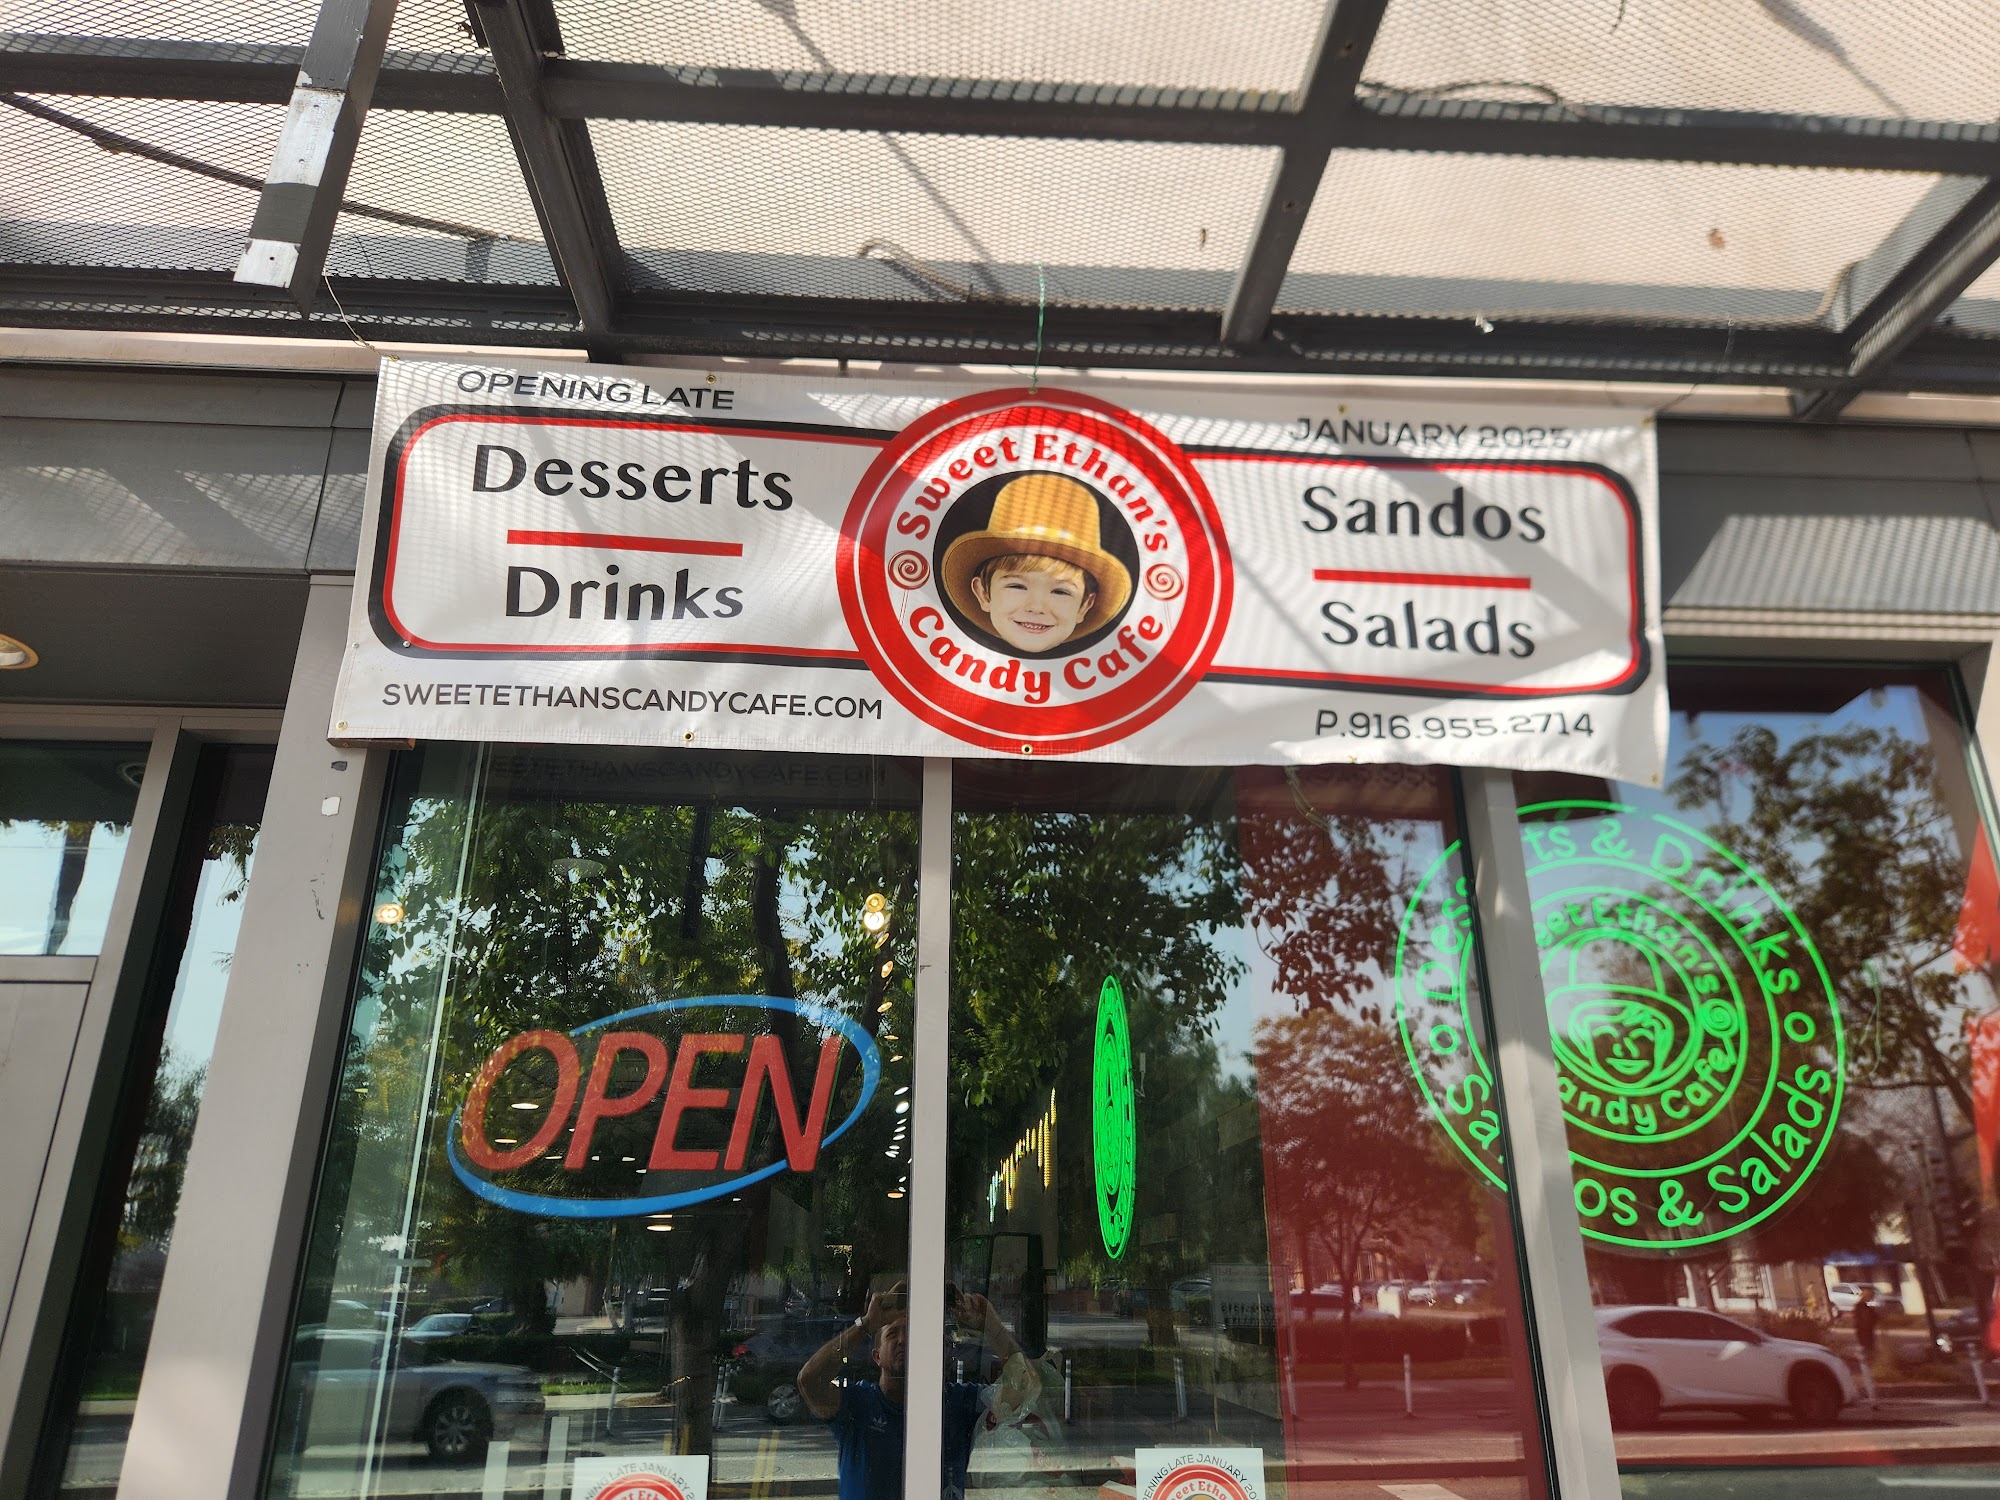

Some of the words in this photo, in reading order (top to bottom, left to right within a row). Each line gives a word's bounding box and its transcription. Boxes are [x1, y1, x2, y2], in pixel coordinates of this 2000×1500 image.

[457, 371, 633, 404] OPENING
[641, 385, 735, 410] LATE
[1289, 418, 1468, 447] JANUARY
[1478, 426, 1573, 449] 2025
[473, 444, 794, 511] Desserts
[897, 436, 1019, 540] Sweet
[1033, 433, 1168, 553] Ethan's
[1302, 485, 1546, 543] Sandos
[506, 564, 744, 621] Drinks
[909, 606, 1050, 704] Candy
[1063, 615, 1163, 690] Cafe
[1321, 601, 1536, 659] Salads
[382, 683, 882, 720] SWEETETHANSCANDYCAFE.COM
[1315, 709, 1594, 739] P.916.955.2714
[1591, 818, 1635, 860] &
[1652, 833, 1800, 995] Drinks
[1592, 897, 1720, 994] Ethan's
[462, 1029, 843, 1171] OPEN
[1555, 1060, 1658, 1135] andy
[1661, 1048, 1732, 1119] Cafe
[1658, 1179, 1704, 1227] &
[1707, 1063, 1832, 1213] Salads
[609, 1462, 637, 1480] LATE
[639, 1462, 690, 1491] JANUARY
[1142, 1467, 1169, 1500] ENING
[1167, 1454, 1194, 1471] LATE
[1196, 1453, 1247, 1483] JANUARY
